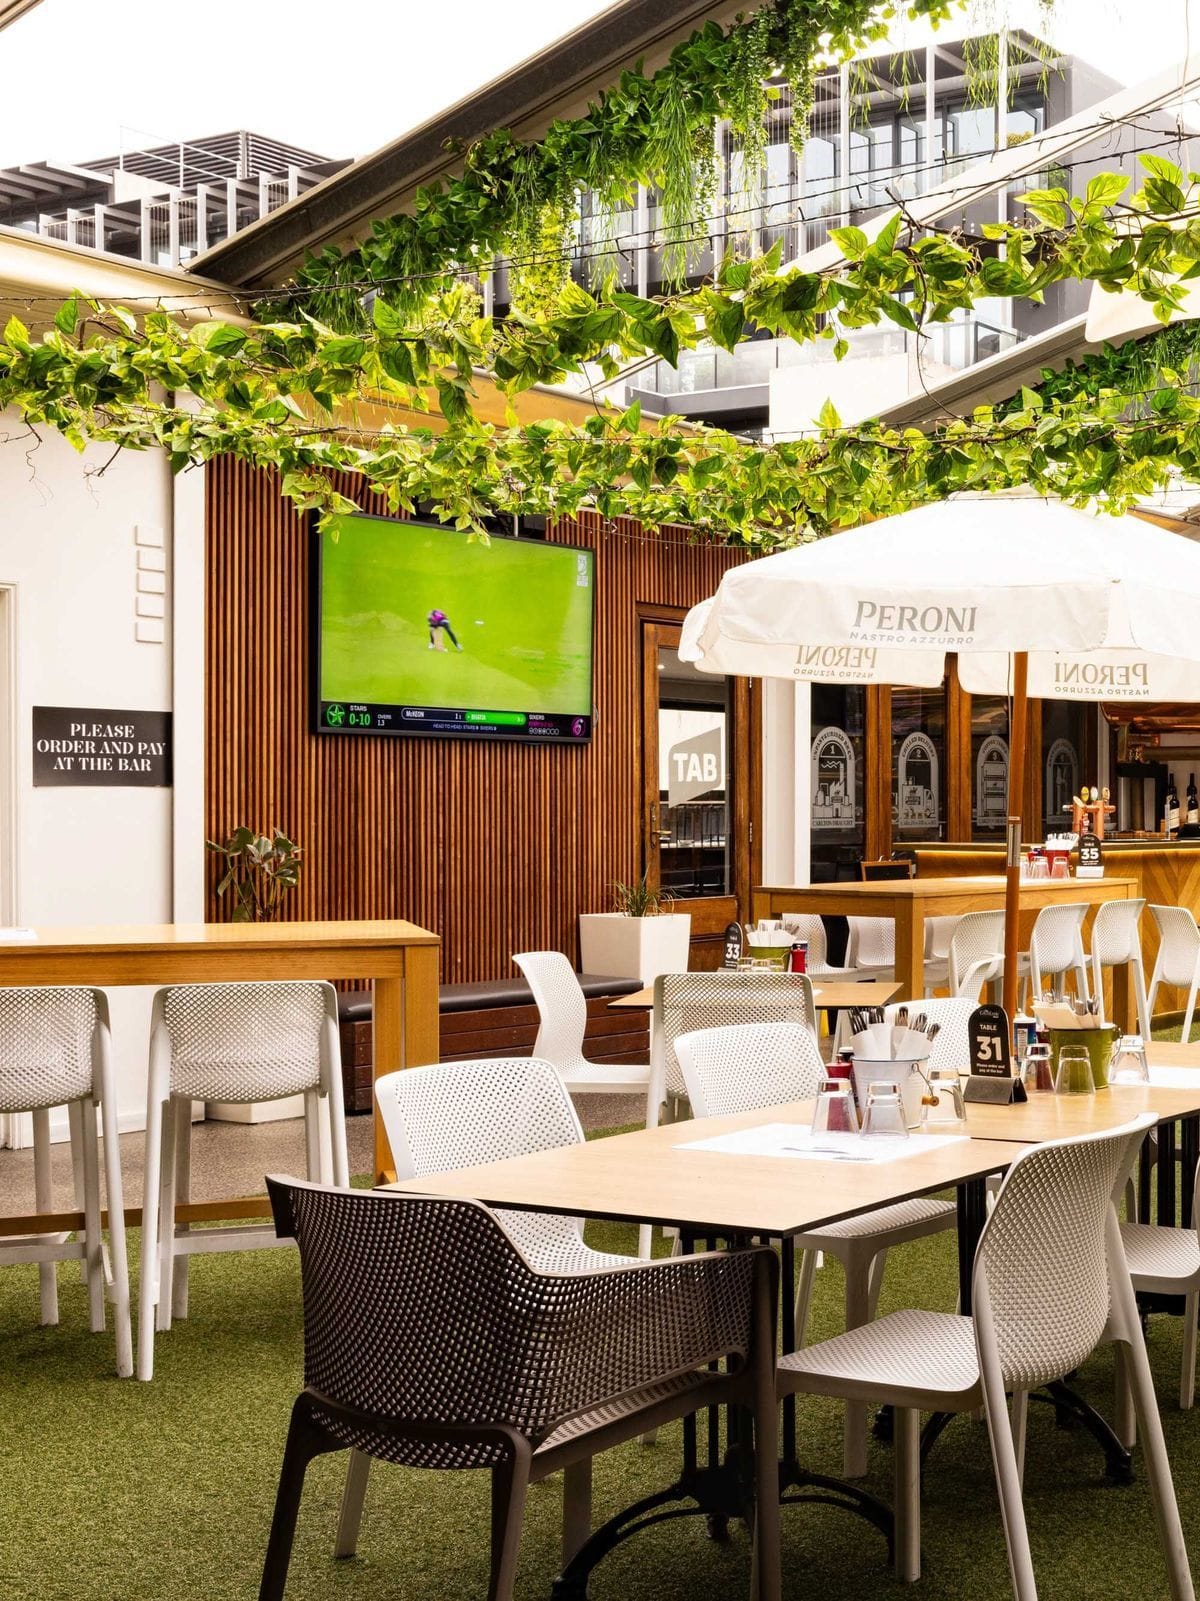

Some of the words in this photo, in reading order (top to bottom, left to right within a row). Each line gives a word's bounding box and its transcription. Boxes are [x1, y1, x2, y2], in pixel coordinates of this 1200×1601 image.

[853, 601, 978, 633] PERONI
[850, 632, 905, 643] NASTRO
[910, 636, 974, 645] AZZURRO
[349, 713, 370, 726] 0-10
[70, 724, 134, 738] PLEASE
[37, 739, 96, 753] ORDER
[100, 741, 134, 754] AND
[138, 742, 166, 755] PAY
[830, 745, 835, 754] 1
[53, 757, 74, 770] AT
[79, 758, 113, 770] THE
[119, 759, 152, 771] BAR
[673, 753, 717, 782] TAB
[1081, 848, 1099, 860] 35
[725, 943, 740, 959] 33
[977, 1036, 1002, 1061] 31
